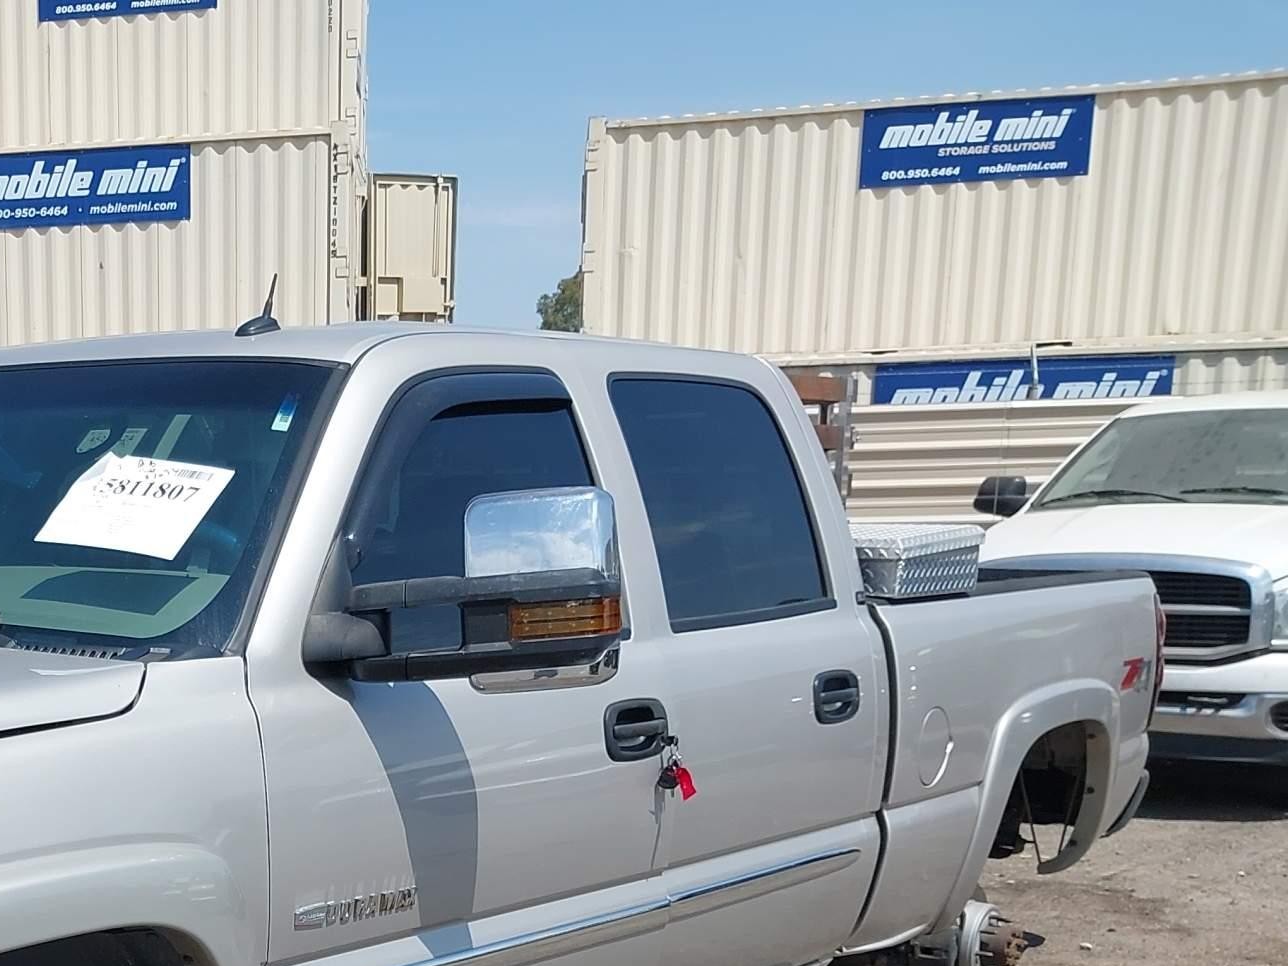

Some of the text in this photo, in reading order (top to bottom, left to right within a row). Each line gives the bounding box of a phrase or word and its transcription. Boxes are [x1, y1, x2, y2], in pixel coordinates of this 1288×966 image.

[55, 2, 117, 14] 800.950.6464
[879, 108, 1072, 149] mobile mini
[937, 141, 1056, 157] STORAGE SOLUTIONS
[96, 159, 180, 196] mini
[882, 160, 1068, 181] 800.950.6464 mobilemini.com
[90, 201, 177, 214] mobilemini.com
